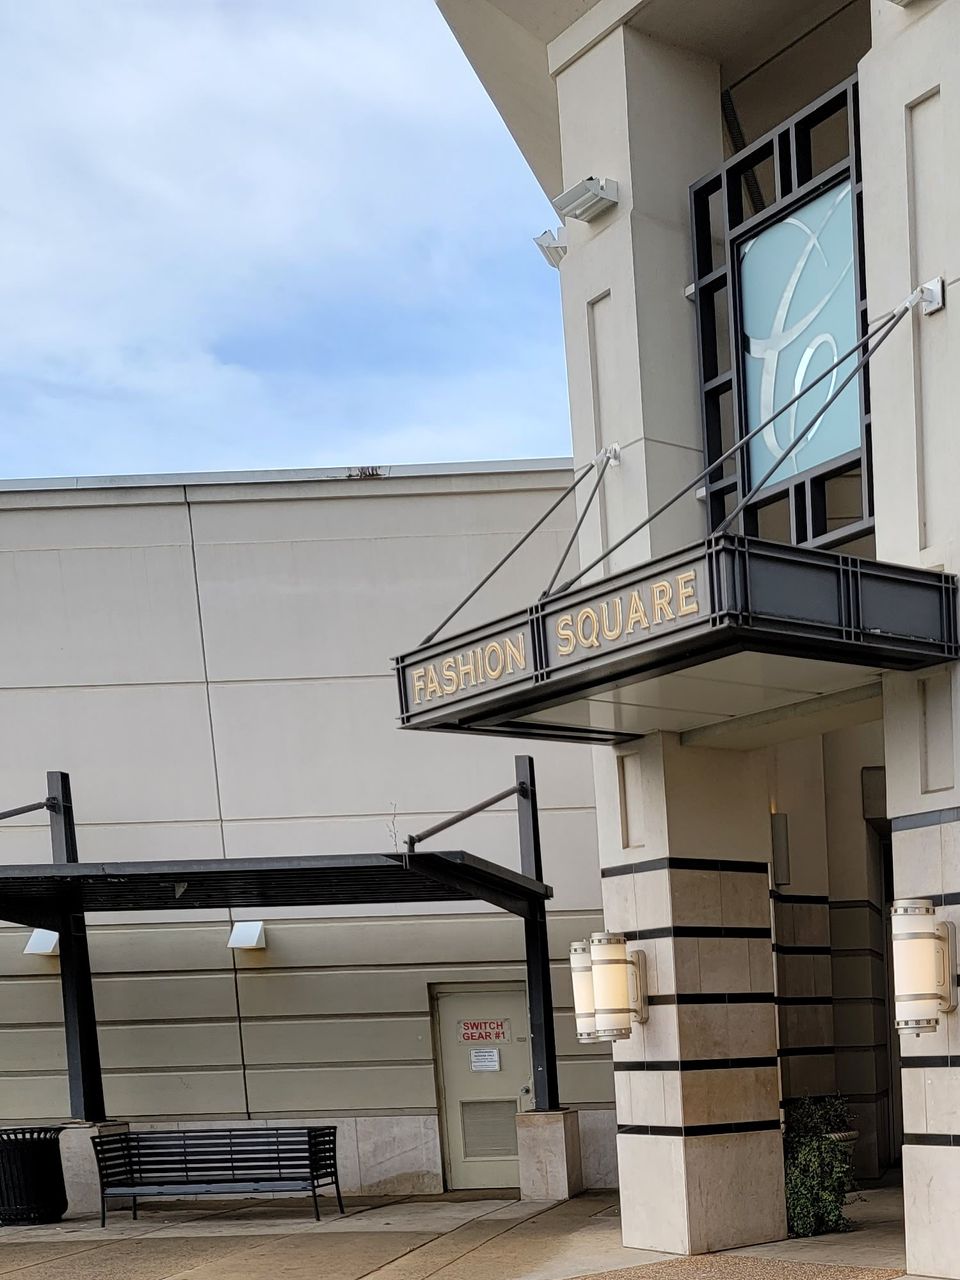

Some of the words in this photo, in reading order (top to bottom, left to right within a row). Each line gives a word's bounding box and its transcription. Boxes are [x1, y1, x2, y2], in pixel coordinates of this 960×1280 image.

[412, 632, 527, 704] FASHION
[556, 569, 700, 657] SQUARE
[463, 1021, 503, 1030] SWITCH
[462, 1031, 491, 1040] GEAR
[494, 1031, 505, 1039] #1
